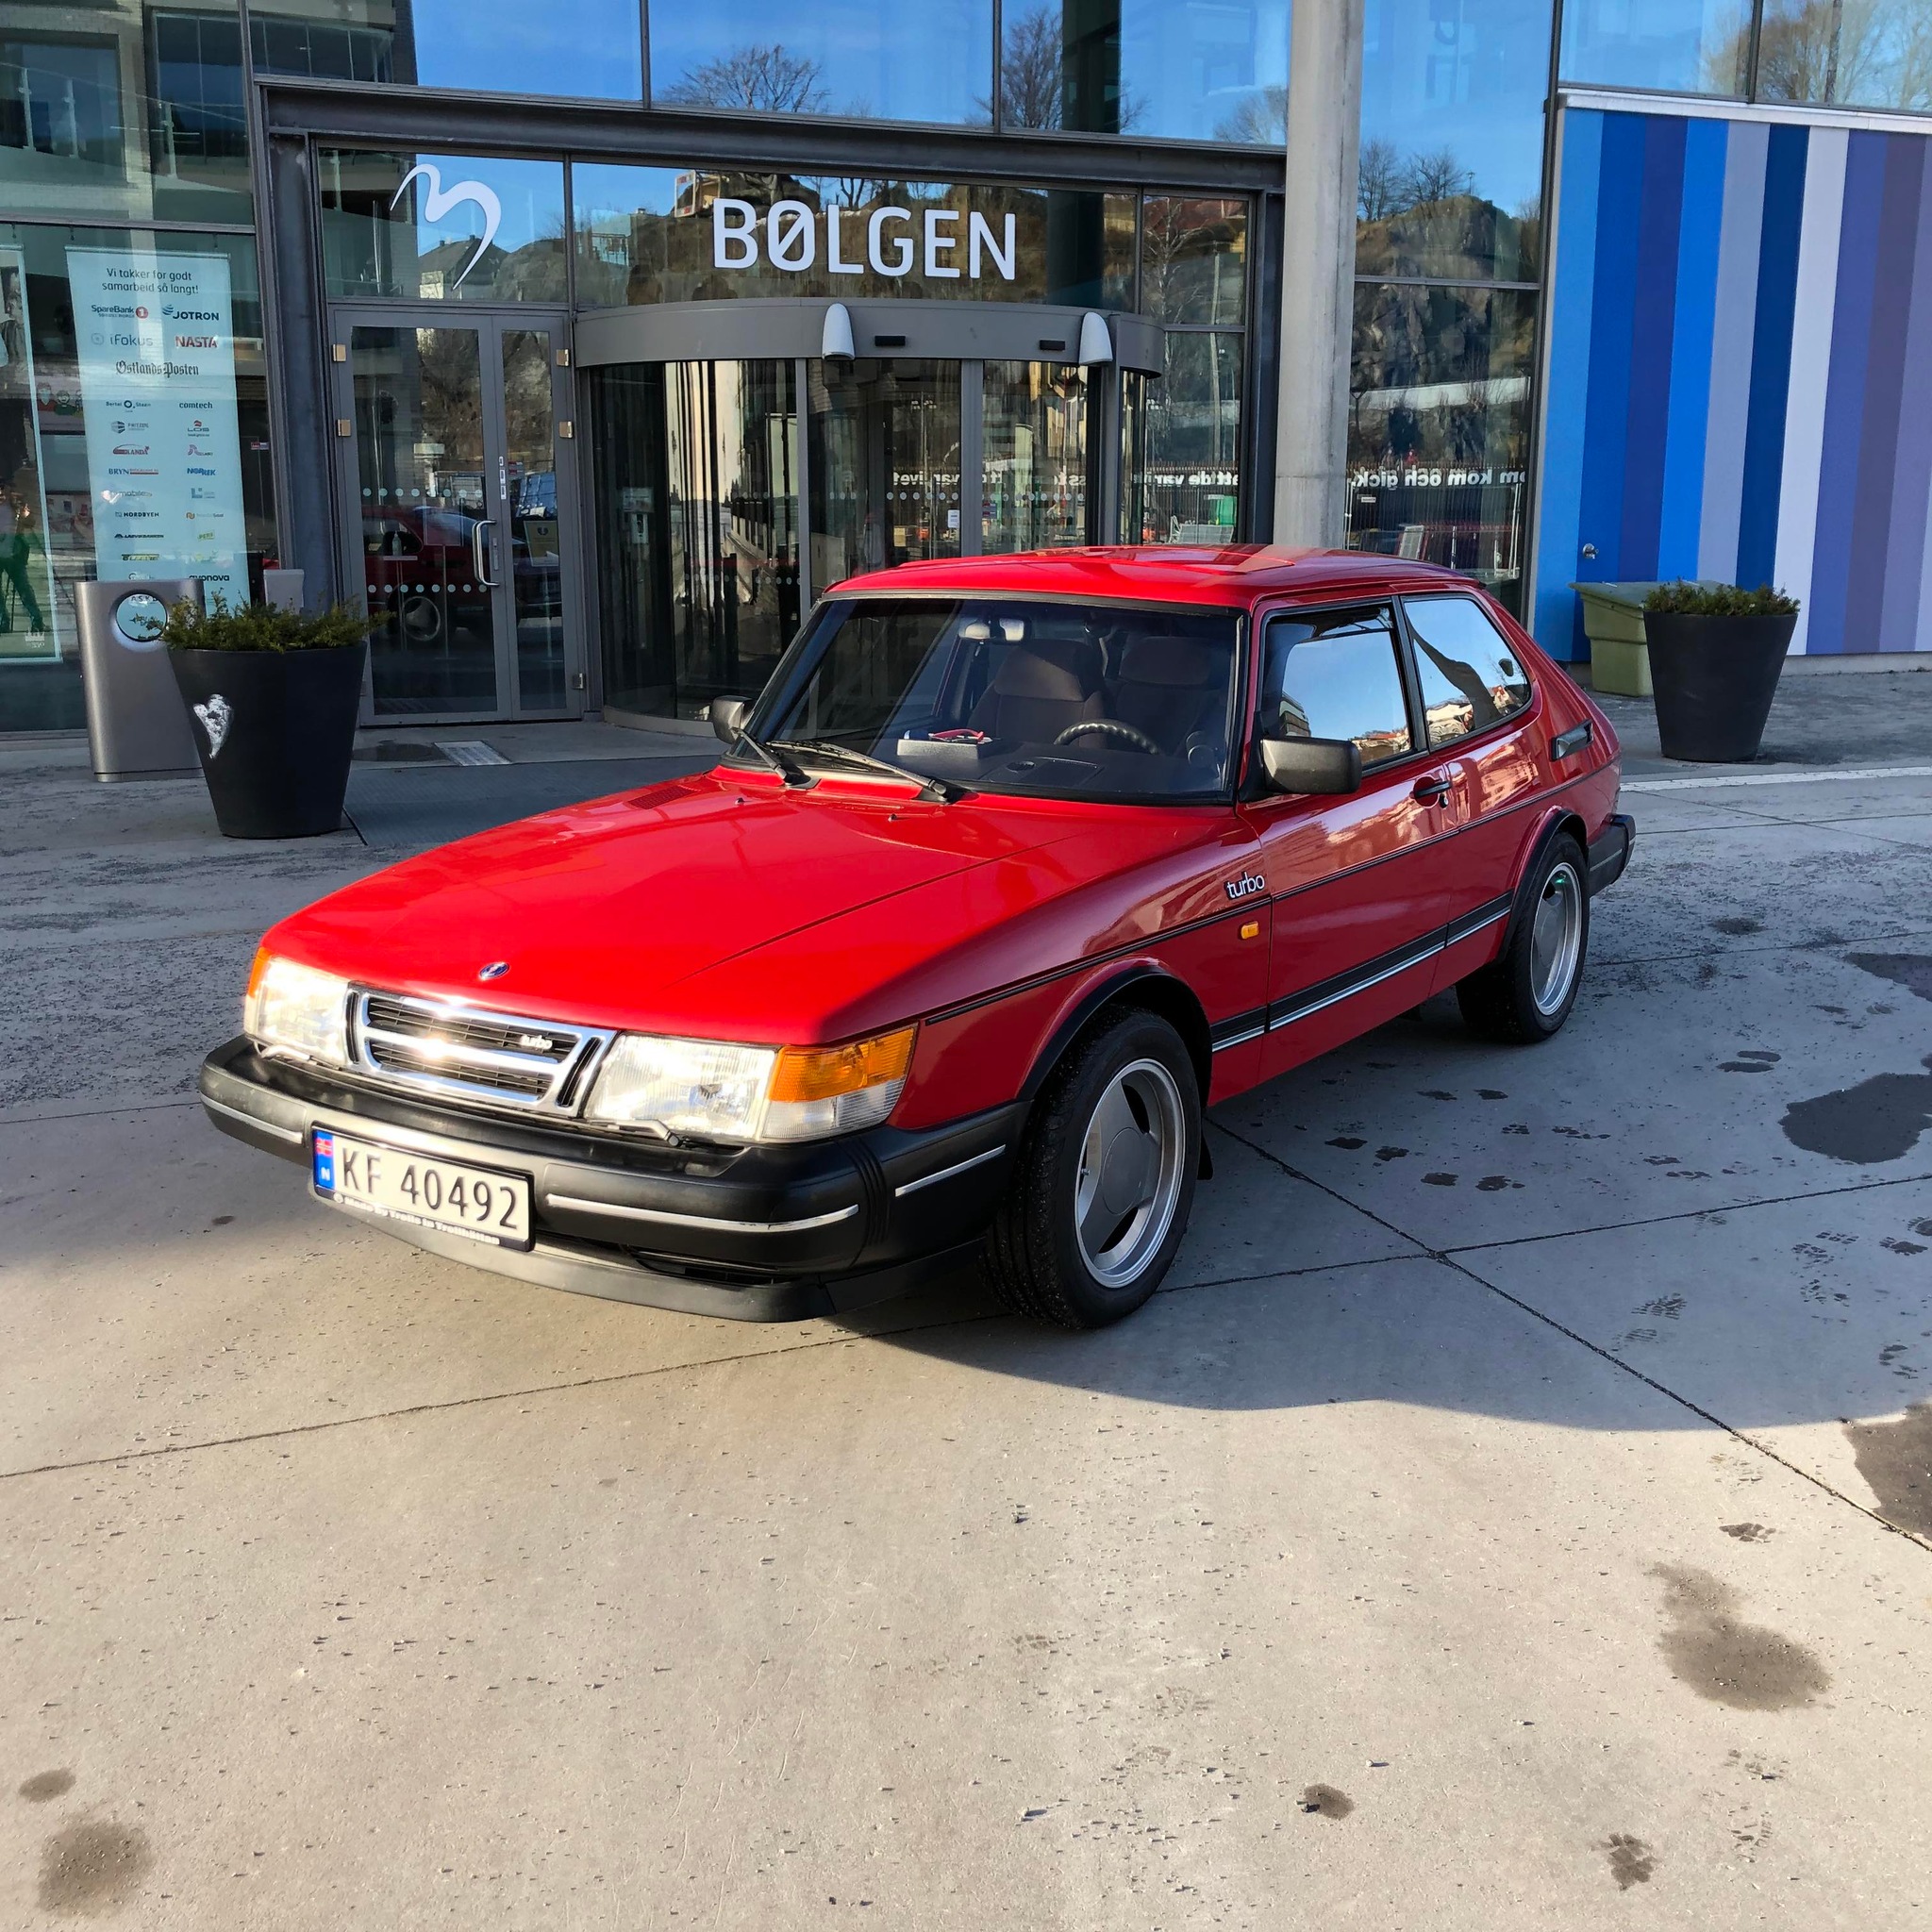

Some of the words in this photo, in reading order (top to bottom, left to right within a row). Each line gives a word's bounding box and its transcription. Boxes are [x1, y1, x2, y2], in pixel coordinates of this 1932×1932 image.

[712, 197, 1016, 281] BØLGEN
[107, 268, 117, 277] Vi
[119, 269, 150, 279] takker
[153, 270, 167, 279] for
[169, 272, 192, 282] godt
[102, 283, 155, 292] samarbeid
[158, 283, 168, 293] så
[171, 284, 199, 296] langt!
[91, 305, 134, 314] SpareBank
[173, 311, 220, 321] JOTRON
[175, 336, 218, 348] NASTA
[179, 401, 213, 409] comtech
[1227, 872, 1266, 899] turbo
[320, 1166, 331, 1181] N
[341, 1147, 382, 1193] KF
[400, 1164, 518, 1230] 40492
